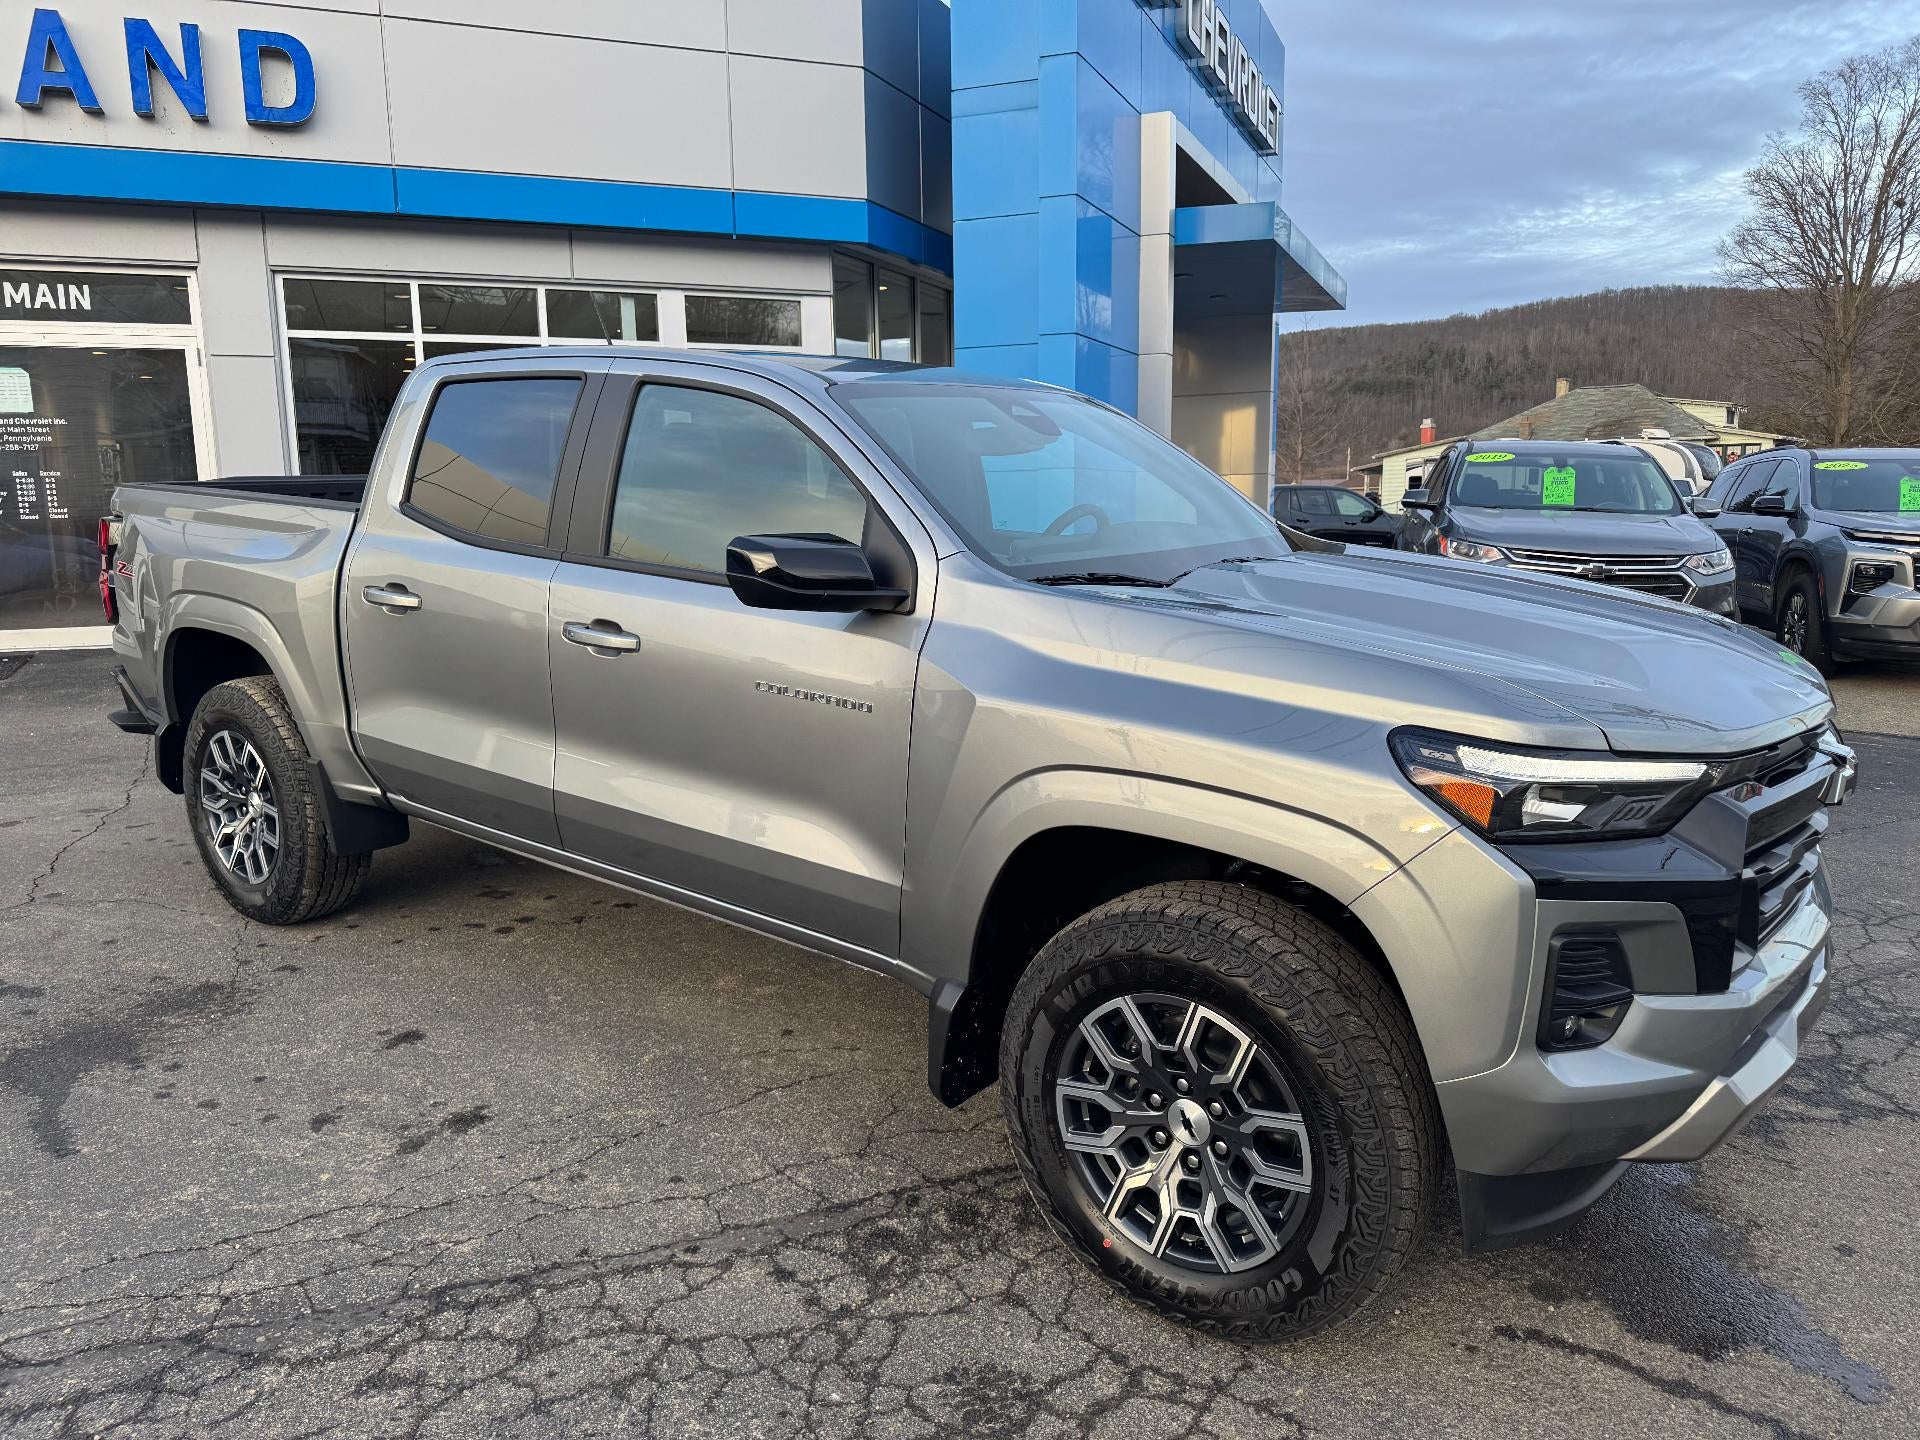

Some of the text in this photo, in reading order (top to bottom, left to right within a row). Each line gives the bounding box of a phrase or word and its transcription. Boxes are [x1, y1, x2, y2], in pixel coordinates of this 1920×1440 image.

[1177, 0, 1284, 156] CHEVROLET
[3, 281, 91, 310] MAIN
[15, 417, 52, 425] Chevrolet
[3, 434, 52, 443] Pennsylvania
[755, 681, 873, 713] COLORADO
